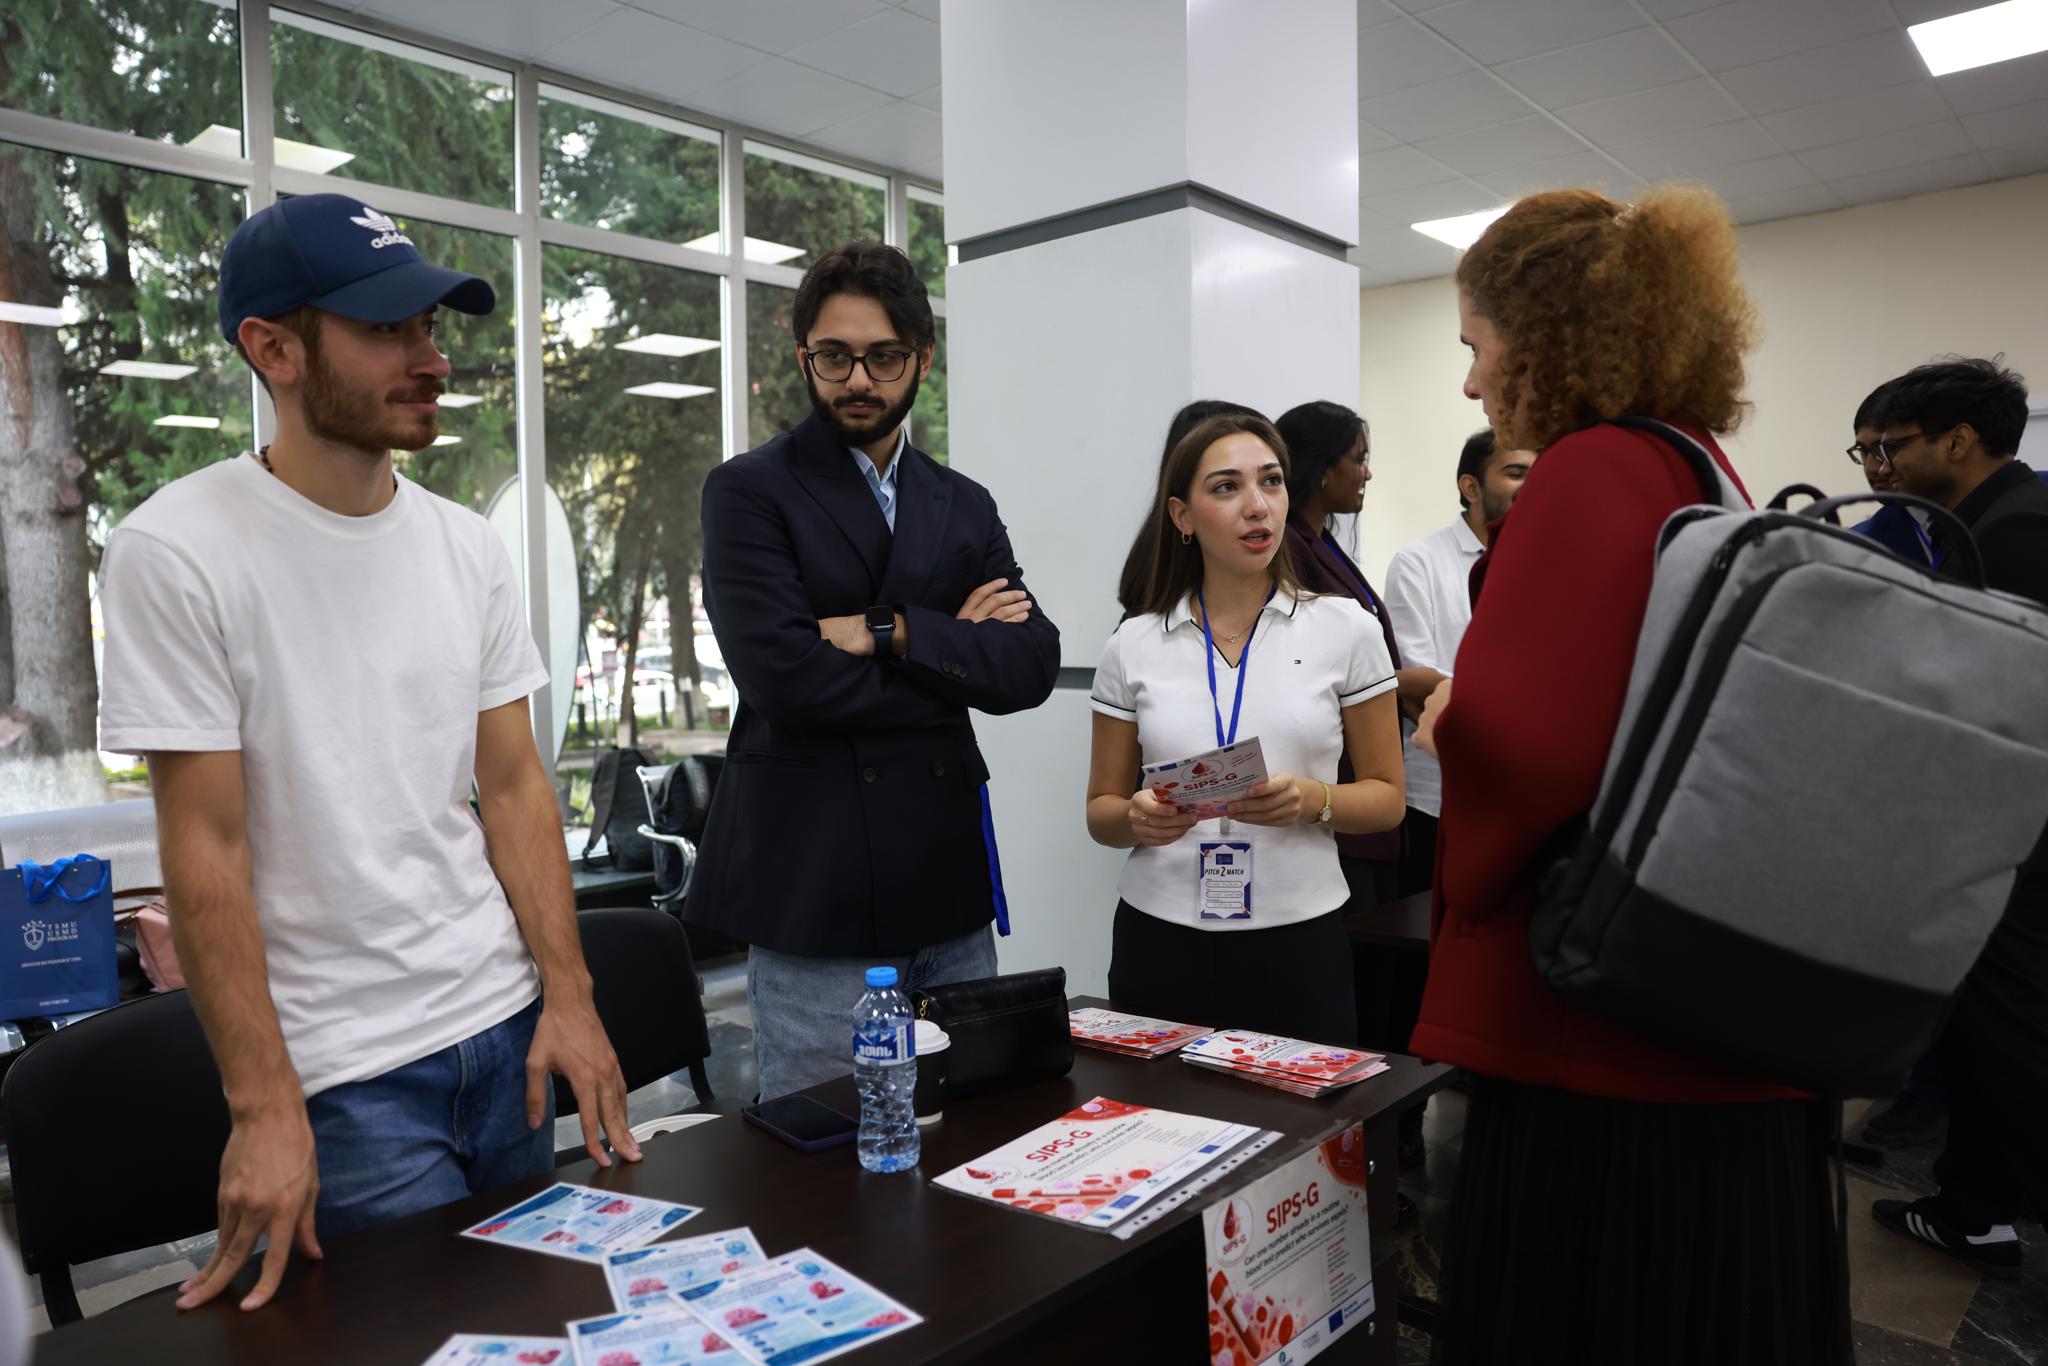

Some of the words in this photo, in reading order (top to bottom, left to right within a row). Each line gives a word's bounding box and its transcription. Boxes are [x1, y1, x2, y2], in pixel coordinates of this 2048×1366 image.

[1183, 772, 1238, 791] SIPS-G
[1204, 868, 1220, 876] PITCH
[1220, 866, 1226, 877] 2
[1226, 868, 1244, 876] MATCH
[1025, 1129, 1094, 1163] SIPS-G
[1266, 1182, 1320, 1234] SIPS-G
